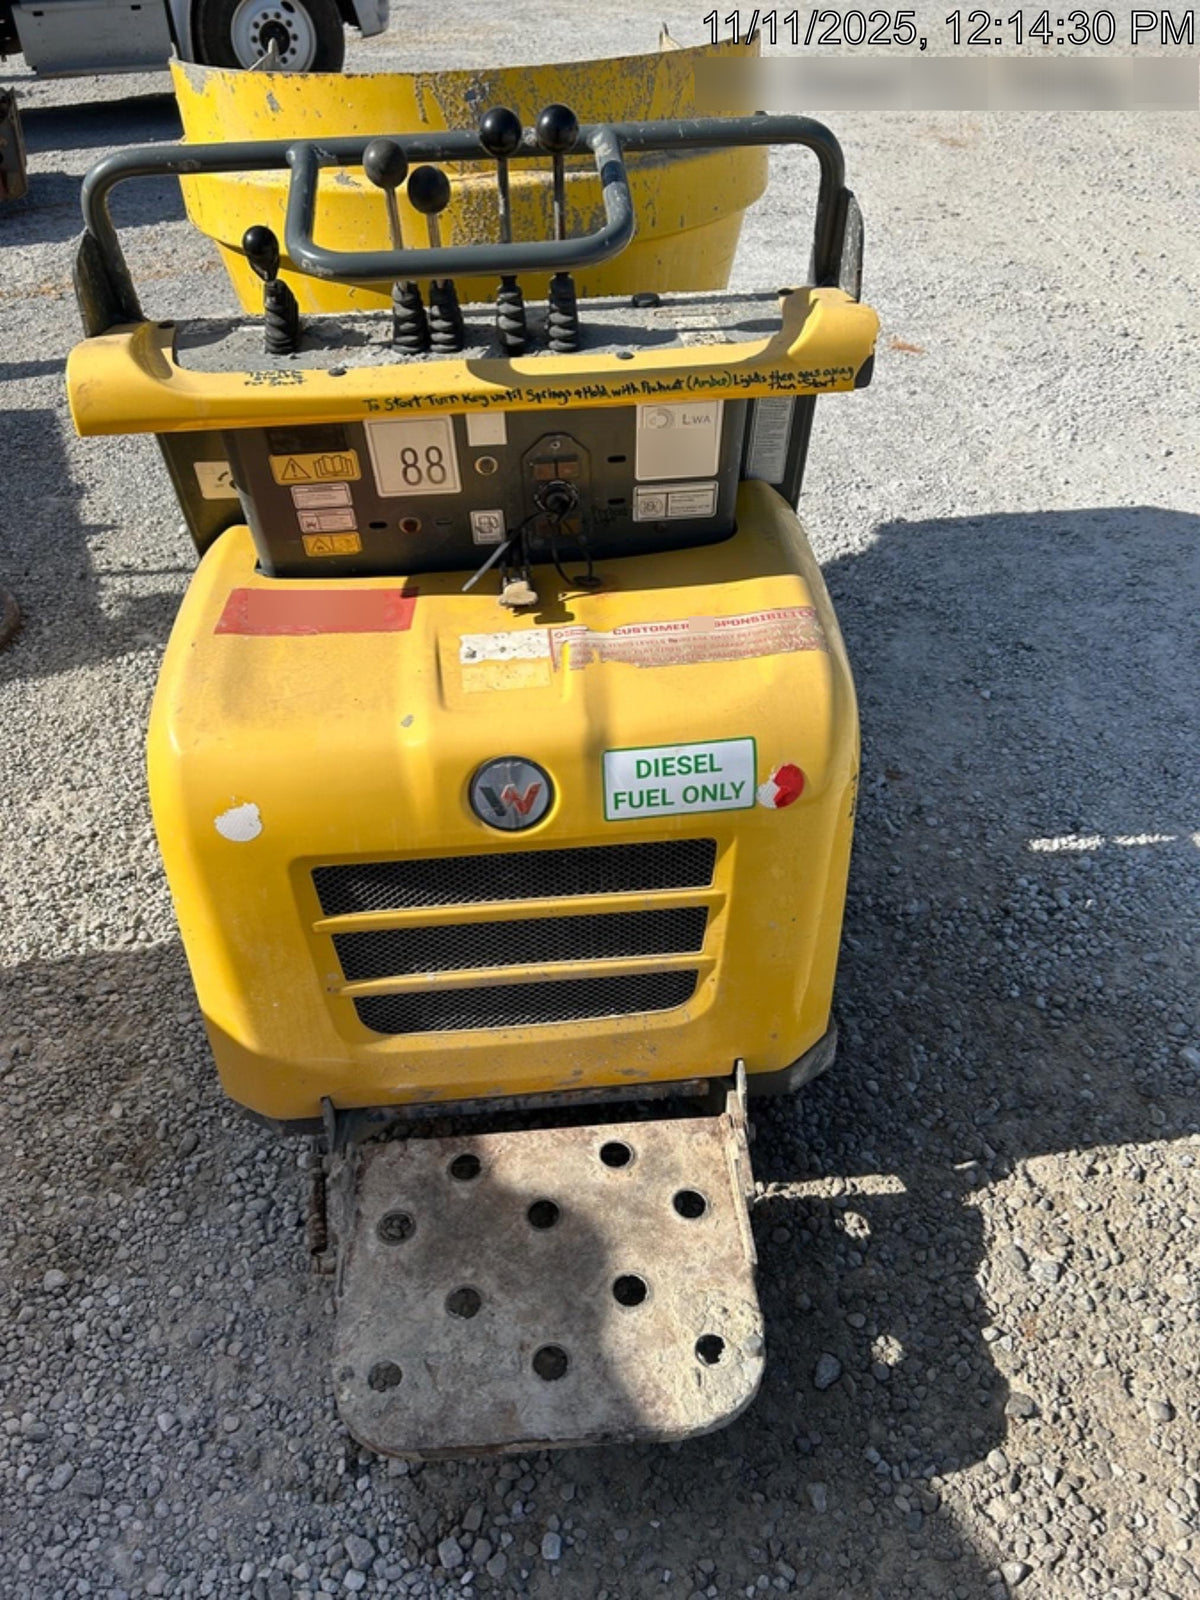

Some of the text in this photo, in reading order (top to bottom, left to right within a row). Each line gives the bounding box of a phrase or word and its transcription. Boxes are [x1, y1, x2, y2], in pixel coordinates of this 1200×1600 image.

[362, 398, 380, 412] To
[384, 395, 422, 412] Start
[425, 394, 459, 406] Turn
[461, 393, 489, 407] Key
[401, 446, 446, 486] 88
[636, 753, 722, 780] DIESEL
[613, 781, 746, 810] FUEL ONLY
